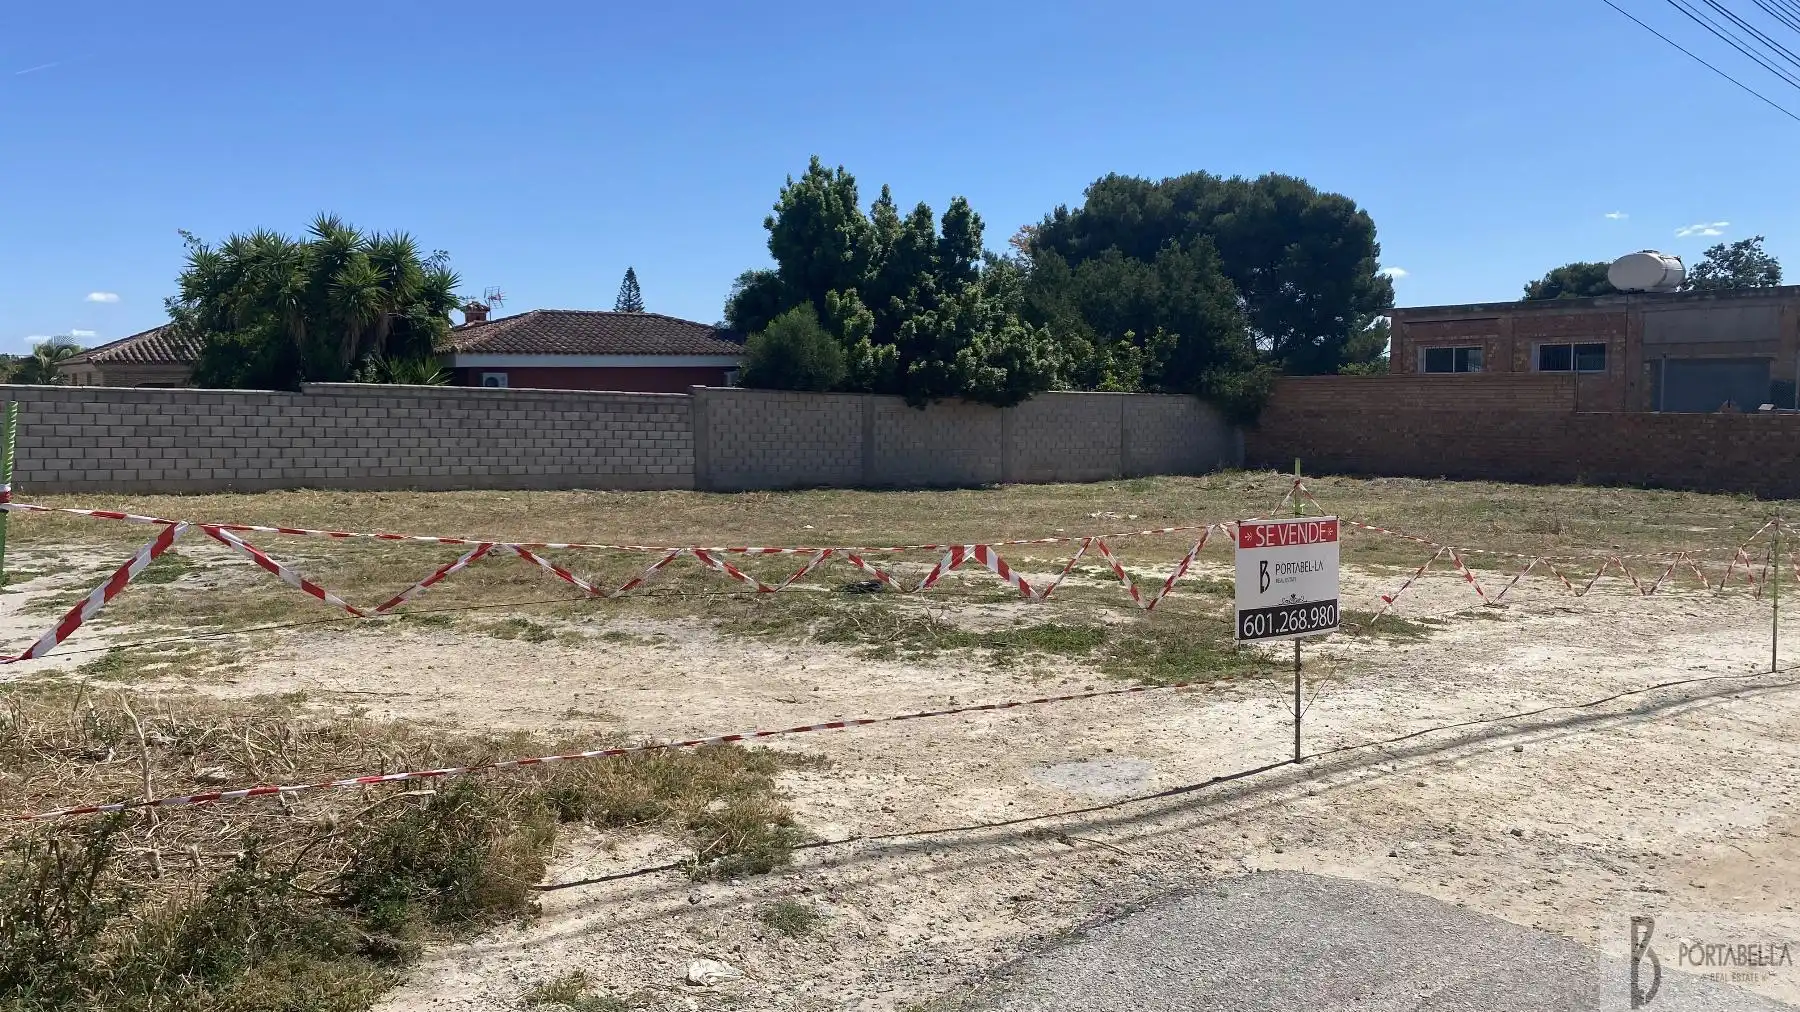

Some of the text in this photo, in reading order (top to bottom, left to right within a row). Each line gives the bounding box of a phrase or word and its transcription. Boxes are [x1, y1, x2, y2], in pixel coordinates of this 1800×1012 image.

[1255, 522, 1327, 547] SE VENDE
[1243, 604, 1335, 637] 601.268.980
